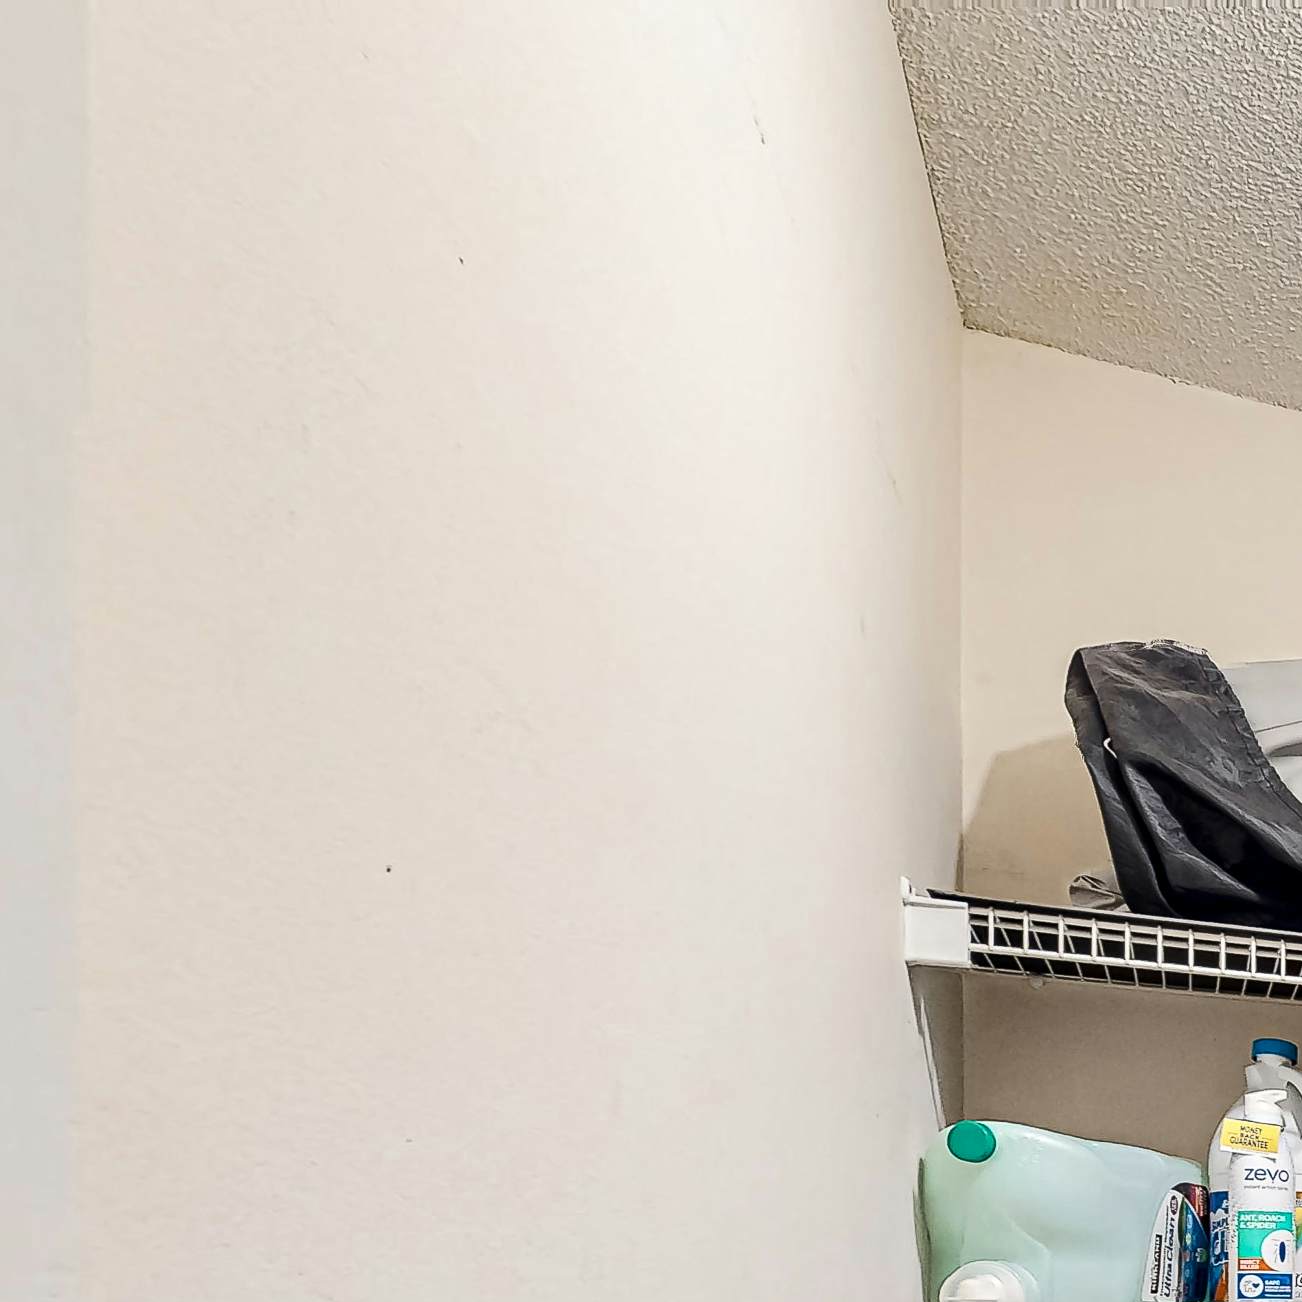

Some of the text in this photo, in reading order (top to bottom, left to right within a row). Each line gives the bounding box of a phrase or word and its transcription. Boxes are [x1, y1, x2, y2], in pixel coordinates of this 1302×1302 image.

[1239, 1125, 1262, 1135] MONEY
[1229, 1136, 1269, 1149] GUARANTEE
[1244, 1168, 1289, 1183] zevo
[1258, 1214, 1286, 1222] ROACH
[1165, 1217, 1176, 1262] Clean
[1163, 1263, 1173, 1298] Ultra
